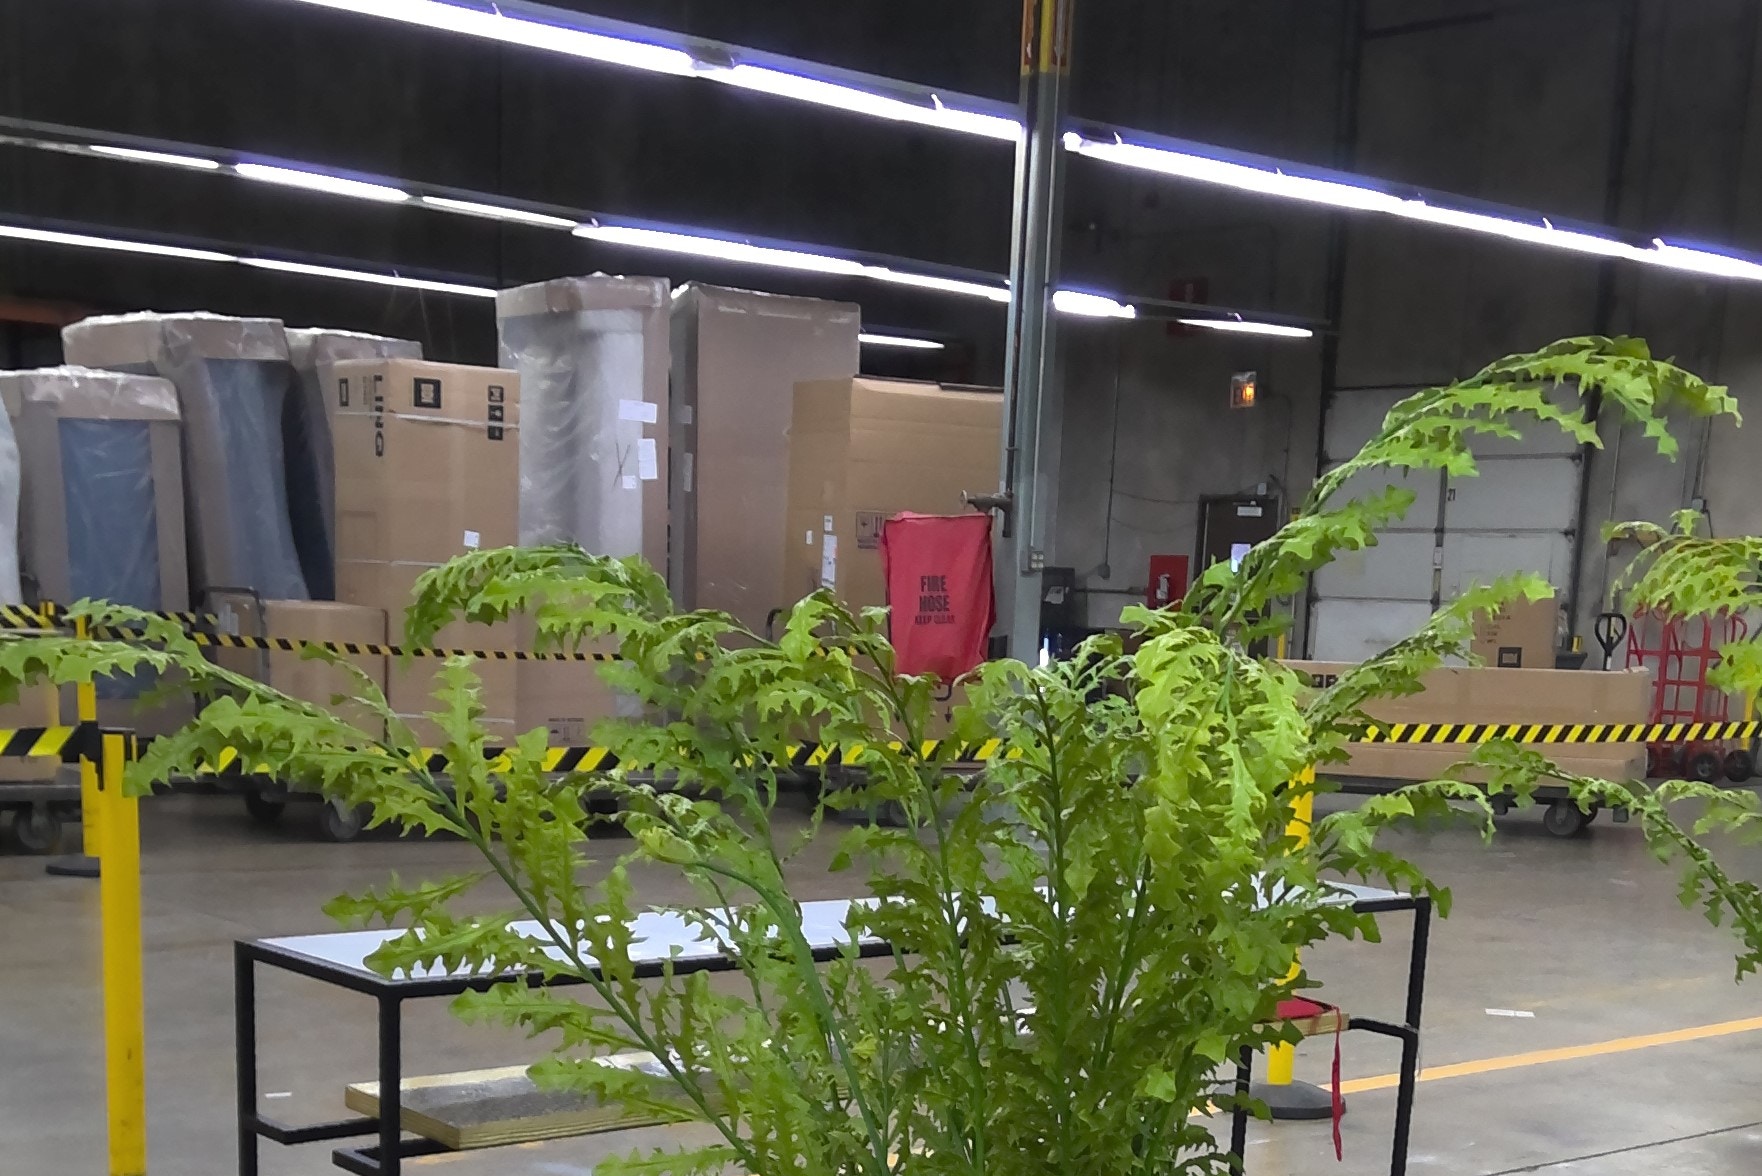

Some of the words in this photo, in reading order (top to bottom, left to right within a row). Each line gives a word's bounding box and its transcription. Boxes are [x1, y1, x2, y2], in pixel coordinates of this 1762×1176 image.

[920, 575, 947, 592] FIRE
[919, 595, 950, 612] HOSE
[915, 615, 932, 625] KEEP
[933, 615, 955, 625] CLEAR
